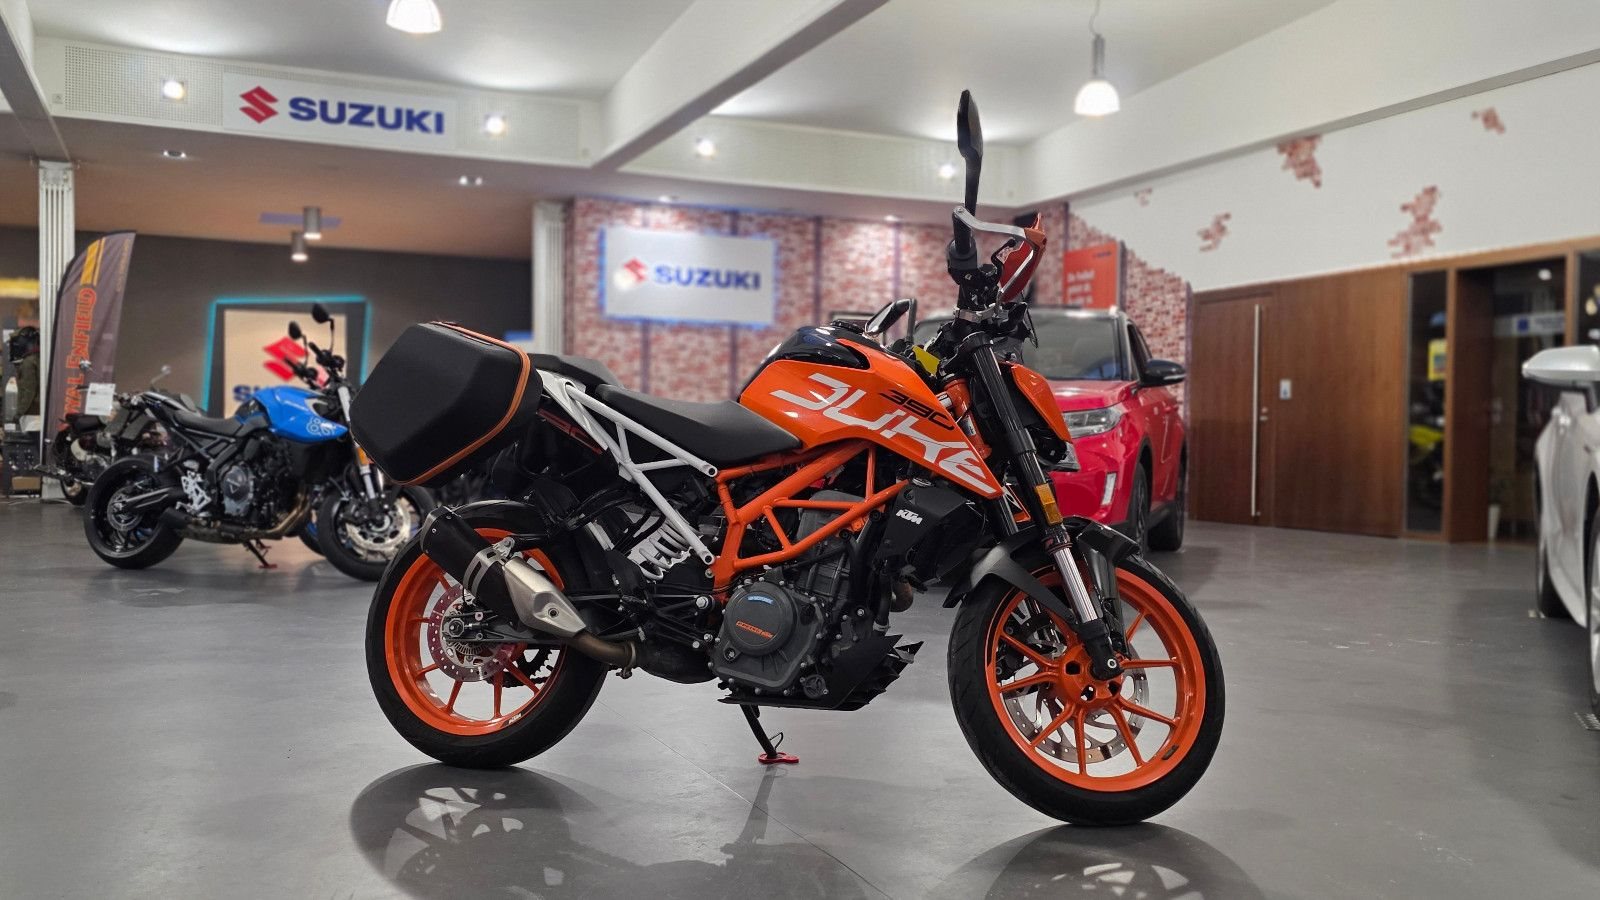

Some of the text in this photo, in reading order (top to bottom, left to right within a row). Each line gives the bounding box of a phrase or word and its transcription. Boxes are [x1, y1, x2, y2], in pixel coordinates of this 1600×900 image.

[289, 97, 444, 134] SUZUKI
[655, 265, 761, 290] SUZUKI
[769, 372, 997, 494] DUKE
[895, 509, 923, 525] KTM
